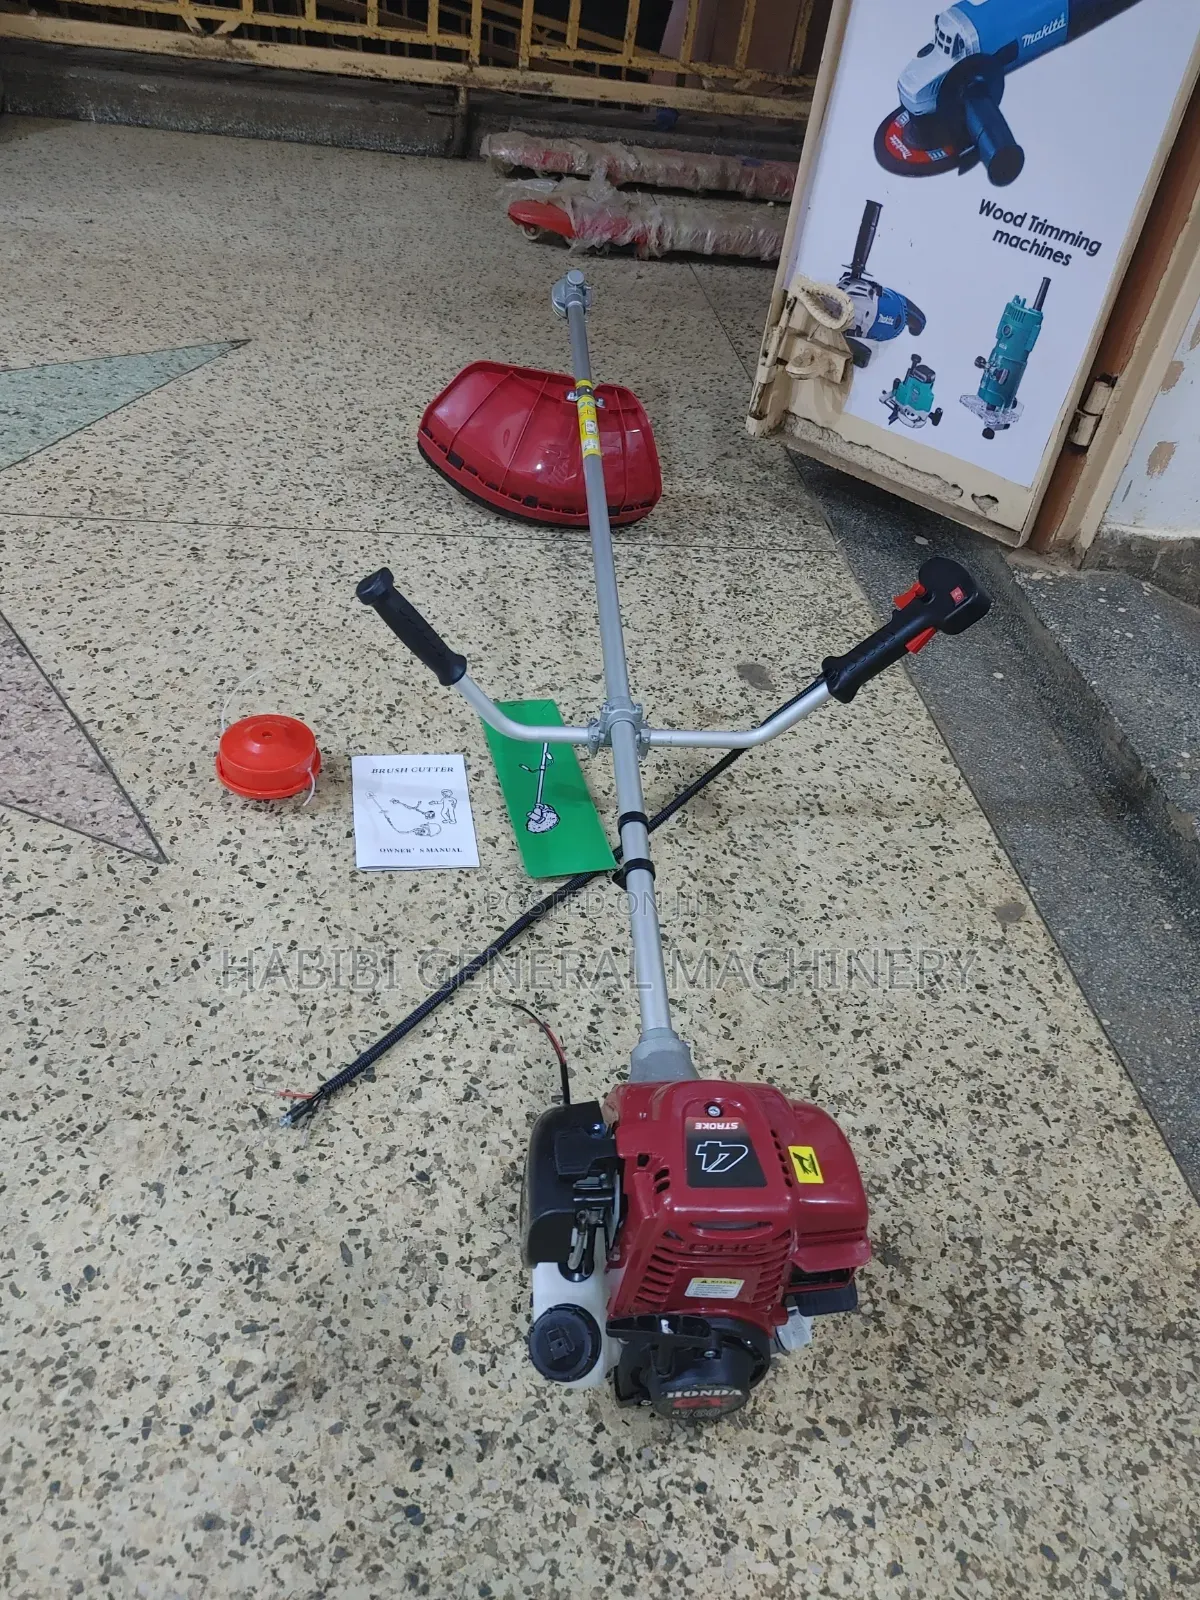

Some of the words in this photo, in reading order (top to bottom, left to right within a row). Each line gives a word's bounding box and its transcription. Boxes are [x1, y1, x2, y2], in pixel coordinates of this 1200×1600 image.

[978, 198, 1028, 228] Wood
[1027, 214, 1103, 257] Trimming
[992, 229, 1072, 267] machines
[694, 1122, 740, 1130] STROKE
[694, 1140, 749, 1173] 4
[666, 1389, 743, 1399] HONDA
